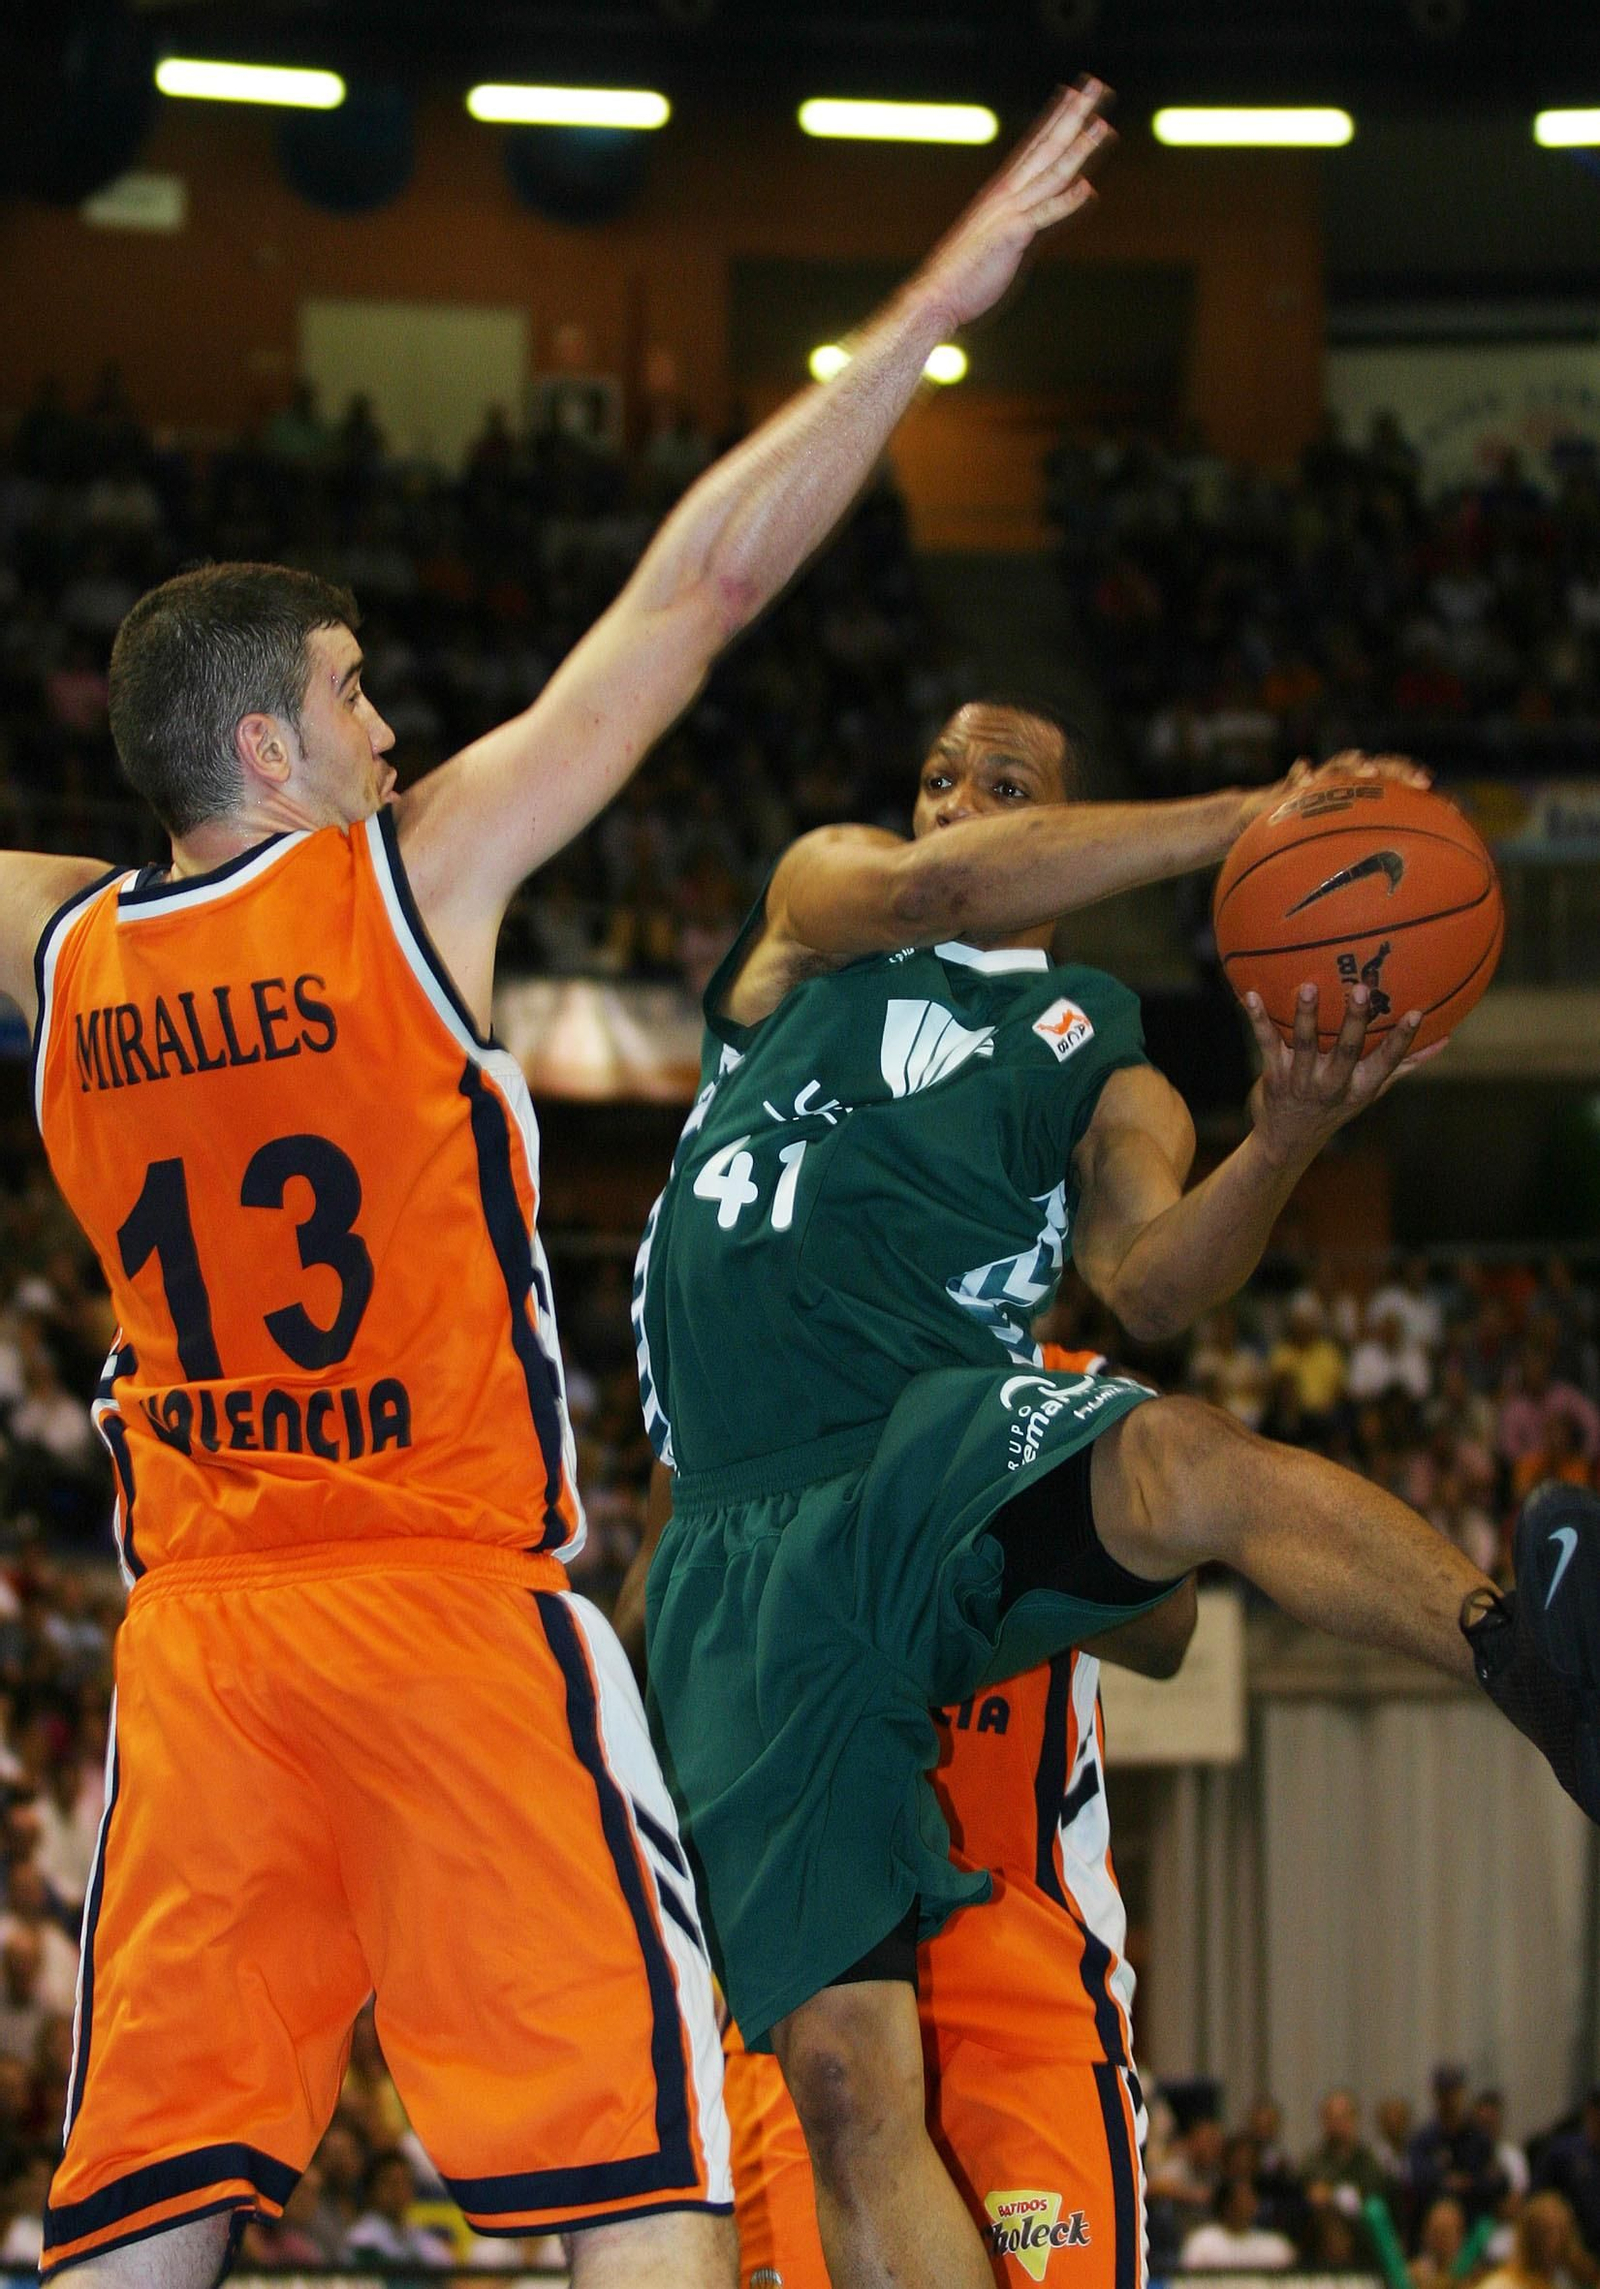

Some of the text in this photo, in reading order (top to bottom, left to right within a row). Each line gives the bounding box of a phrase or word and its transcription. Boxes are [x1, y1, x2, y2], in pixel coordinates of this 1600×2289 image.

[75, 974, 338, 1092] MIRALLES
[693, 1135, 807, 1231] 41
[116, 1133, 374, 1381] 13
[1008, 1405, 1032, 1471] RUPO
[987, 2211, 1091, 2255] holeck
[998, 2199, 1048, 2217] BATIDOS
